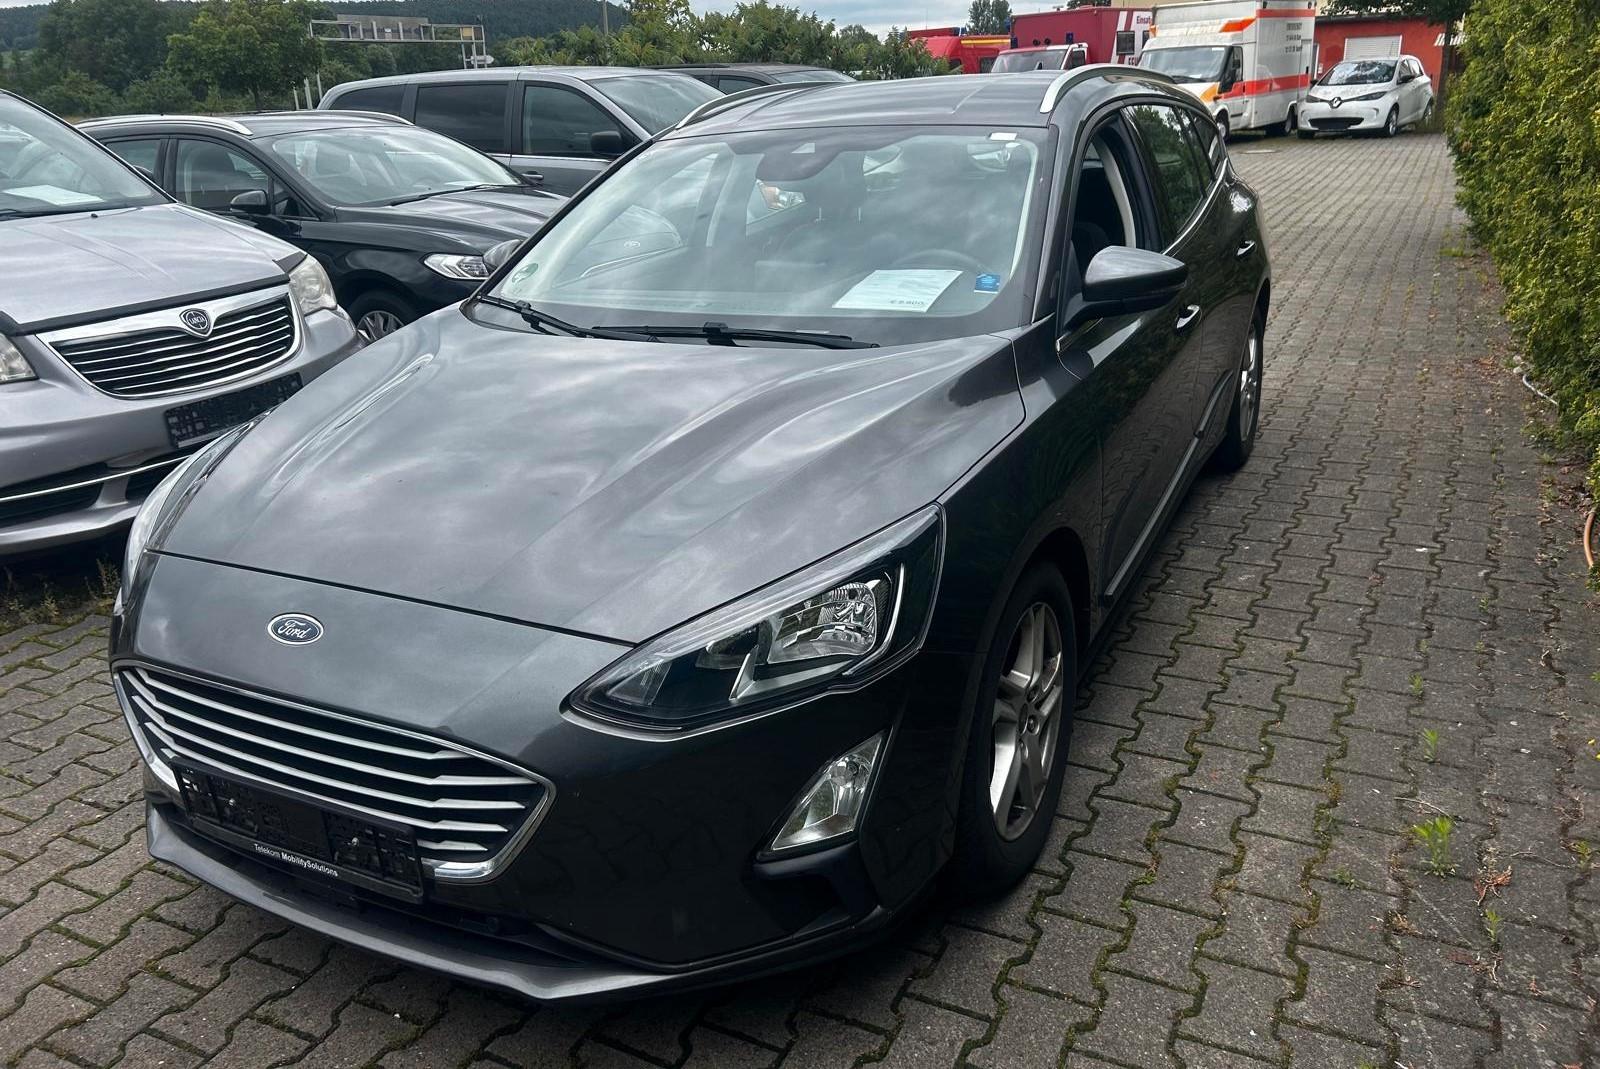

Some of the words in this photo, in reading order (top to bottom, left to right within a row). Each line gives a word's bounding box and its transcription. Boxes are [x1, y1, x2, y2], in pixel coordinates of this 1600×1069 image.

[277, 619, 312, 639] Ford
[253, 843, 280, 858] Telekom
[281, 851, 339, 877] MobilitySolutions
